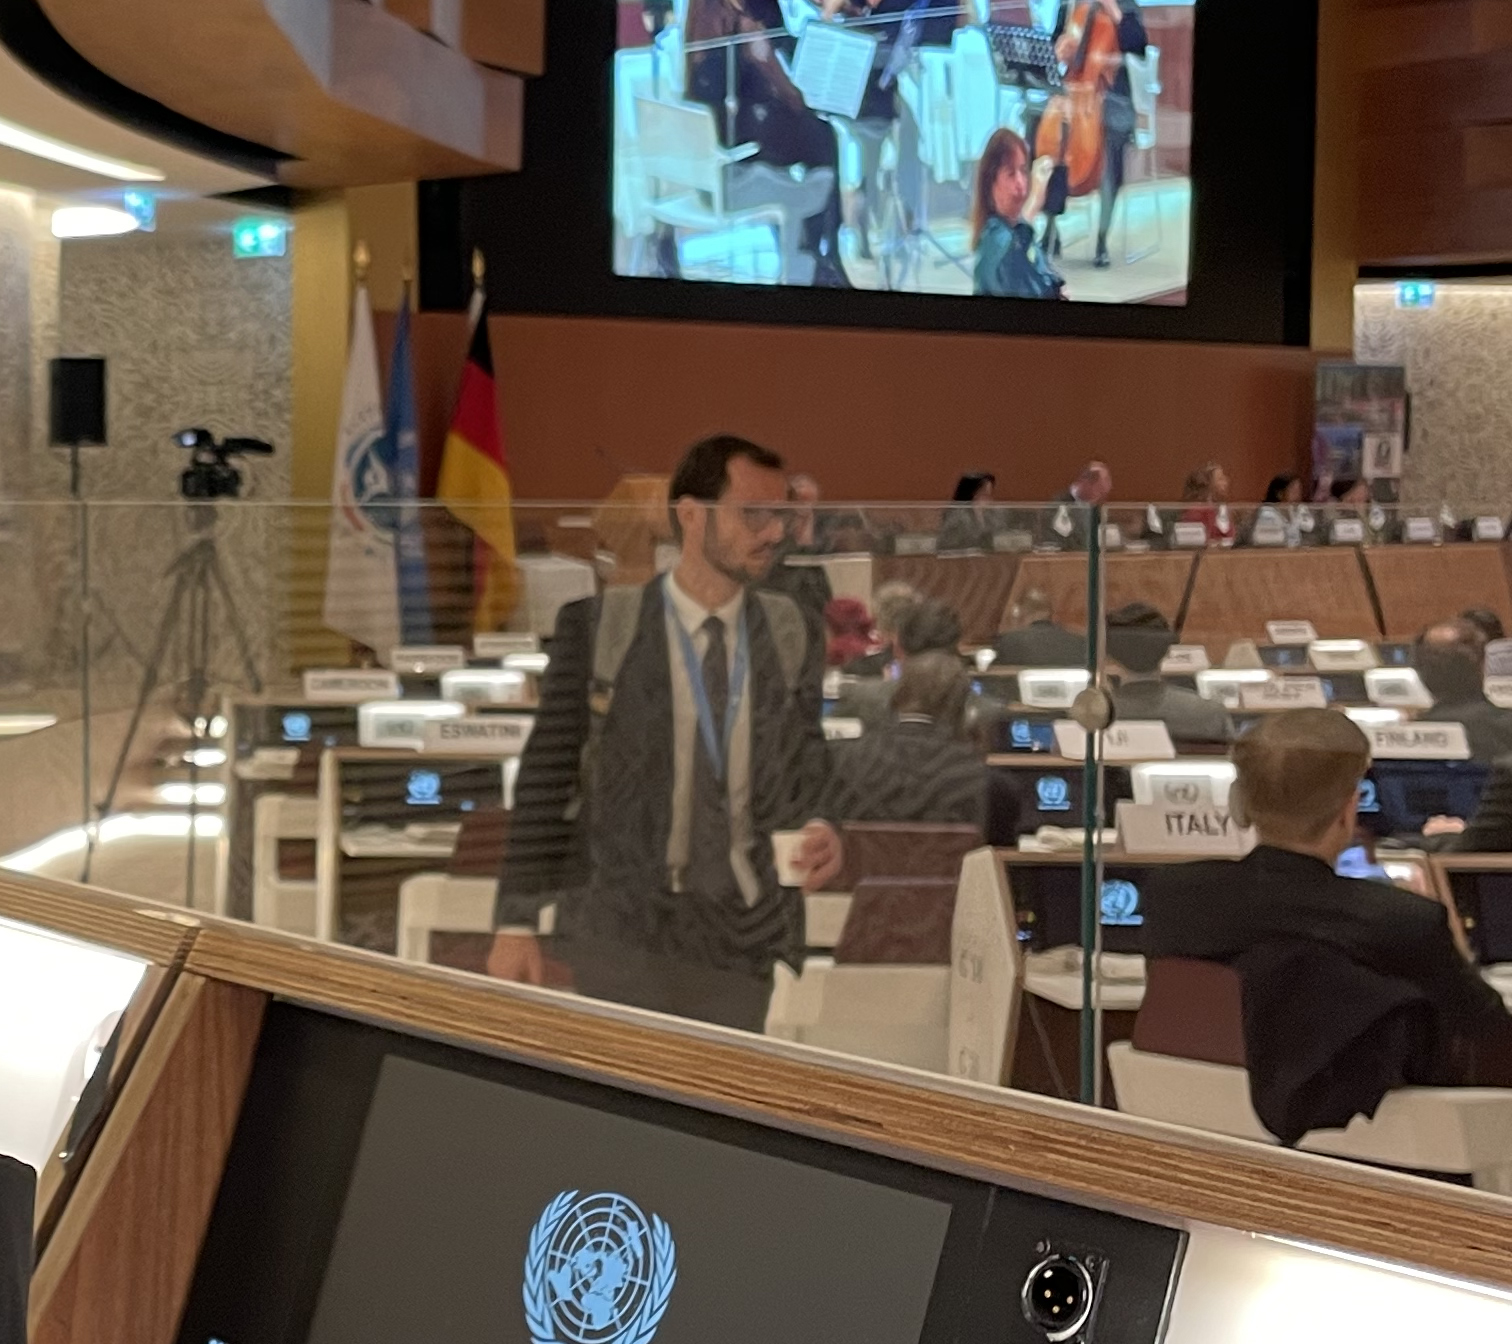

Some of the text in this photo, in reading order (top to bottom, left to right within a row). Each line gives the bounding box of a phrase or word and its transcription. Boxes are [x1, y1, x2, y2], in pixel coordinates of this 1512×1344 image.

[440, 722, 521, 739] ESWATINI
[1374, 731, 1448, 746] FINLAND
[1165, 812, 1231, 837] ITALY
